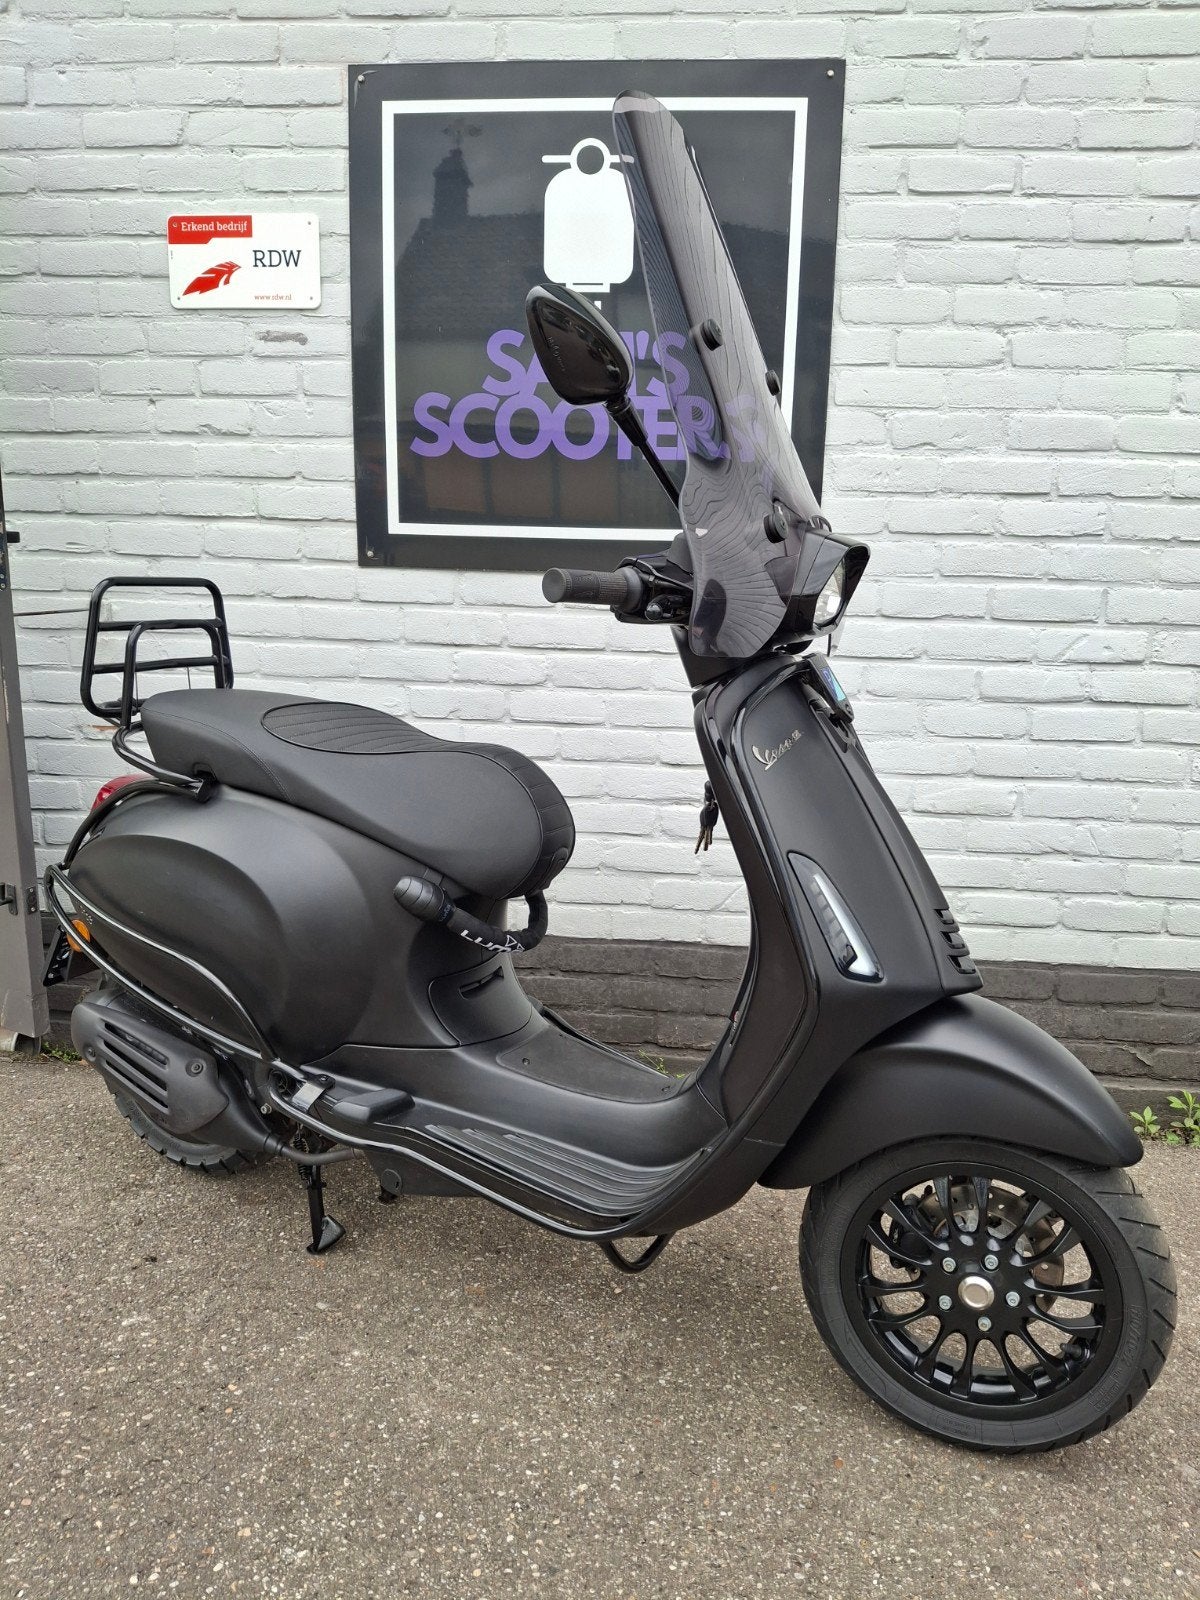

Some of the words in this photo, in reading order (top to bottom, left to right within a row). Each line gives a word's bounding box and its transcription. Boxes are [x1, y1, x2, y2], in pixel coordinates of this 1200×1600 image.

[181, 221, 215, 232] Erkend
[216, 221, 248, 233] bedrijf
[252, 249, 302, 268] RDW
[253, 293, 293, 301] www.rdw.nl
[482, 329, 690, 397] S'S
